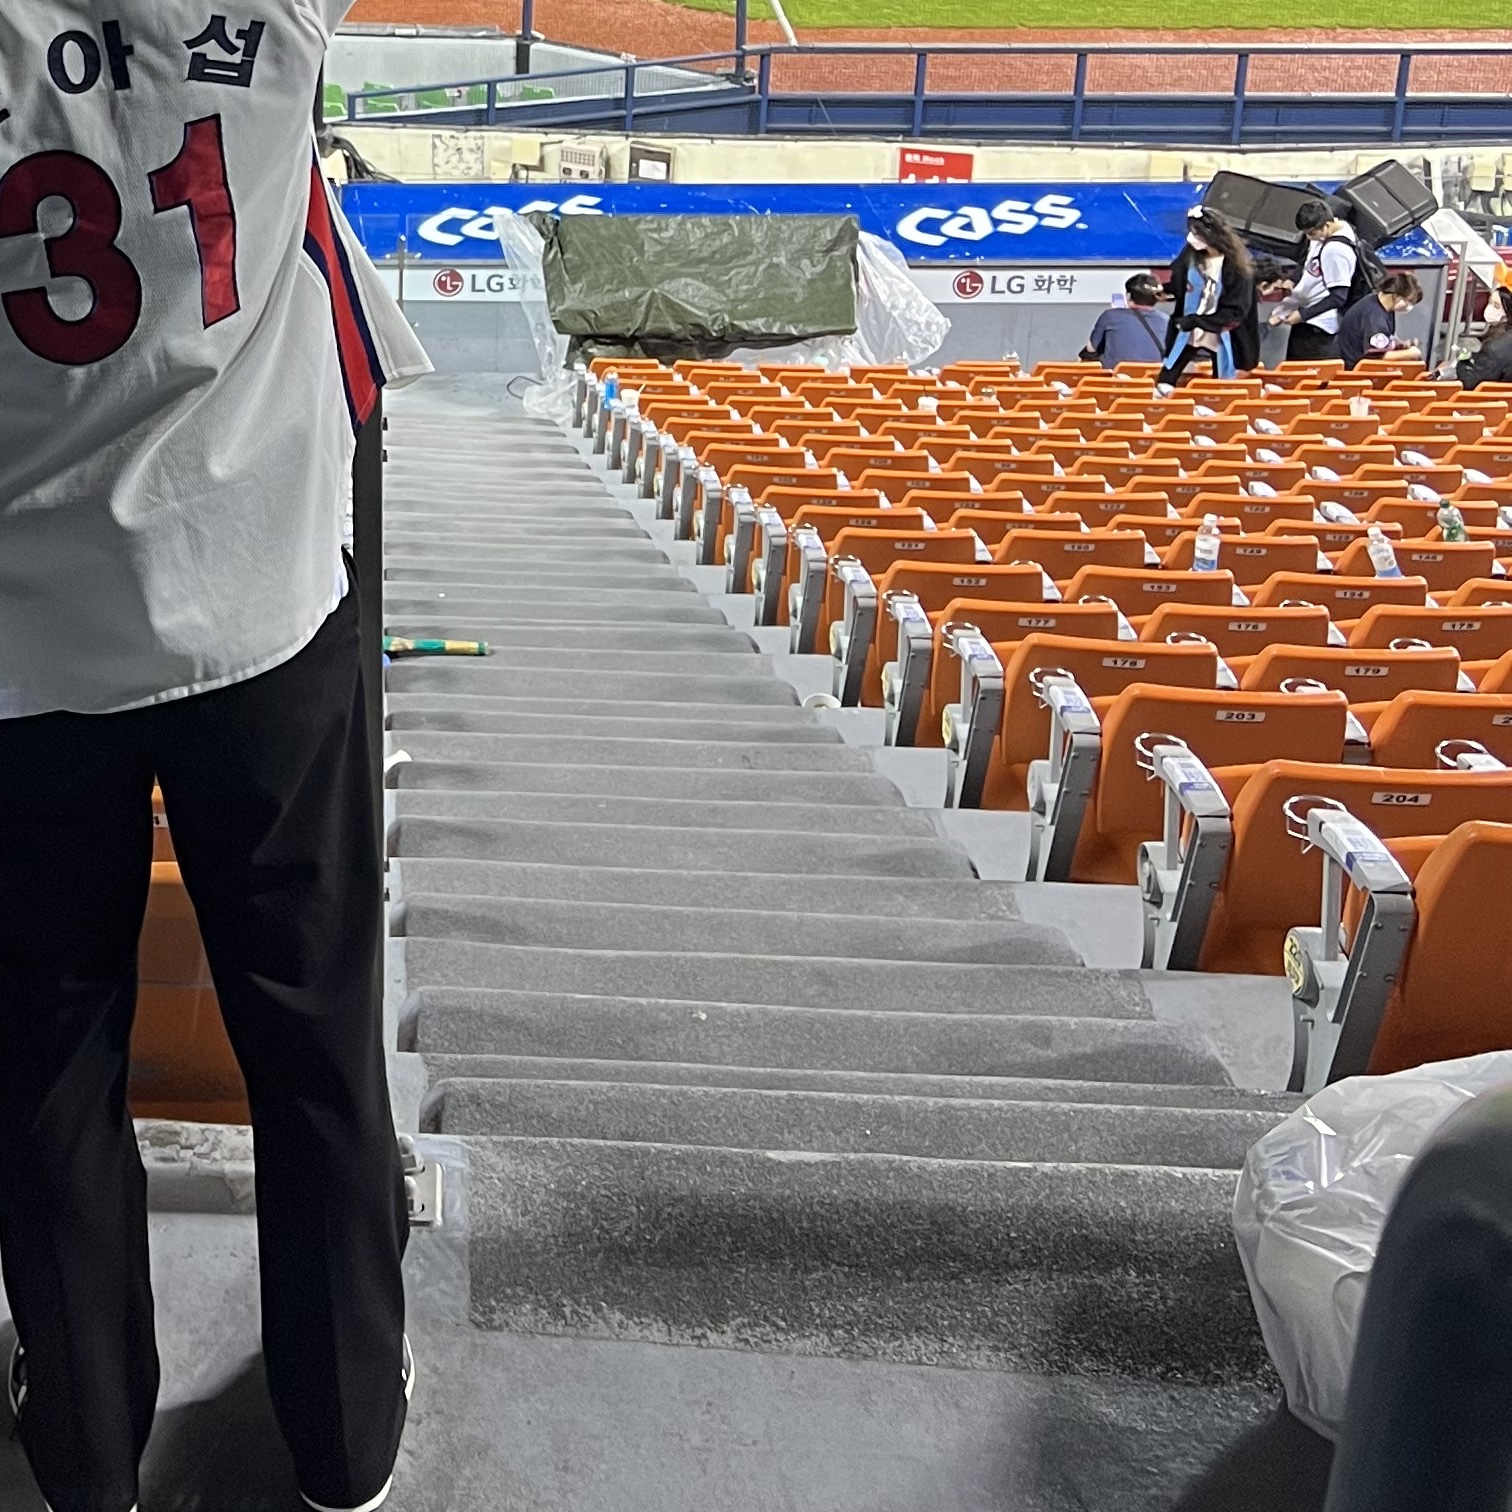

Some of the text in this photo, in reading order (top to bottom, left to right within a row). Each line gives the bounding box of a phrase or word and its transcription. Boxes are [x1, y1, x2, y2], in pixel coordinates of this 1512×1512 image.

[470, 274, 505, 294] LG
[990, 273, 1077, 295] LG 화학
[1354, 667, 1379, 675] 179
[1225, 712, 1256, 721] 203
[1382, 794, 1419, 803] 204
